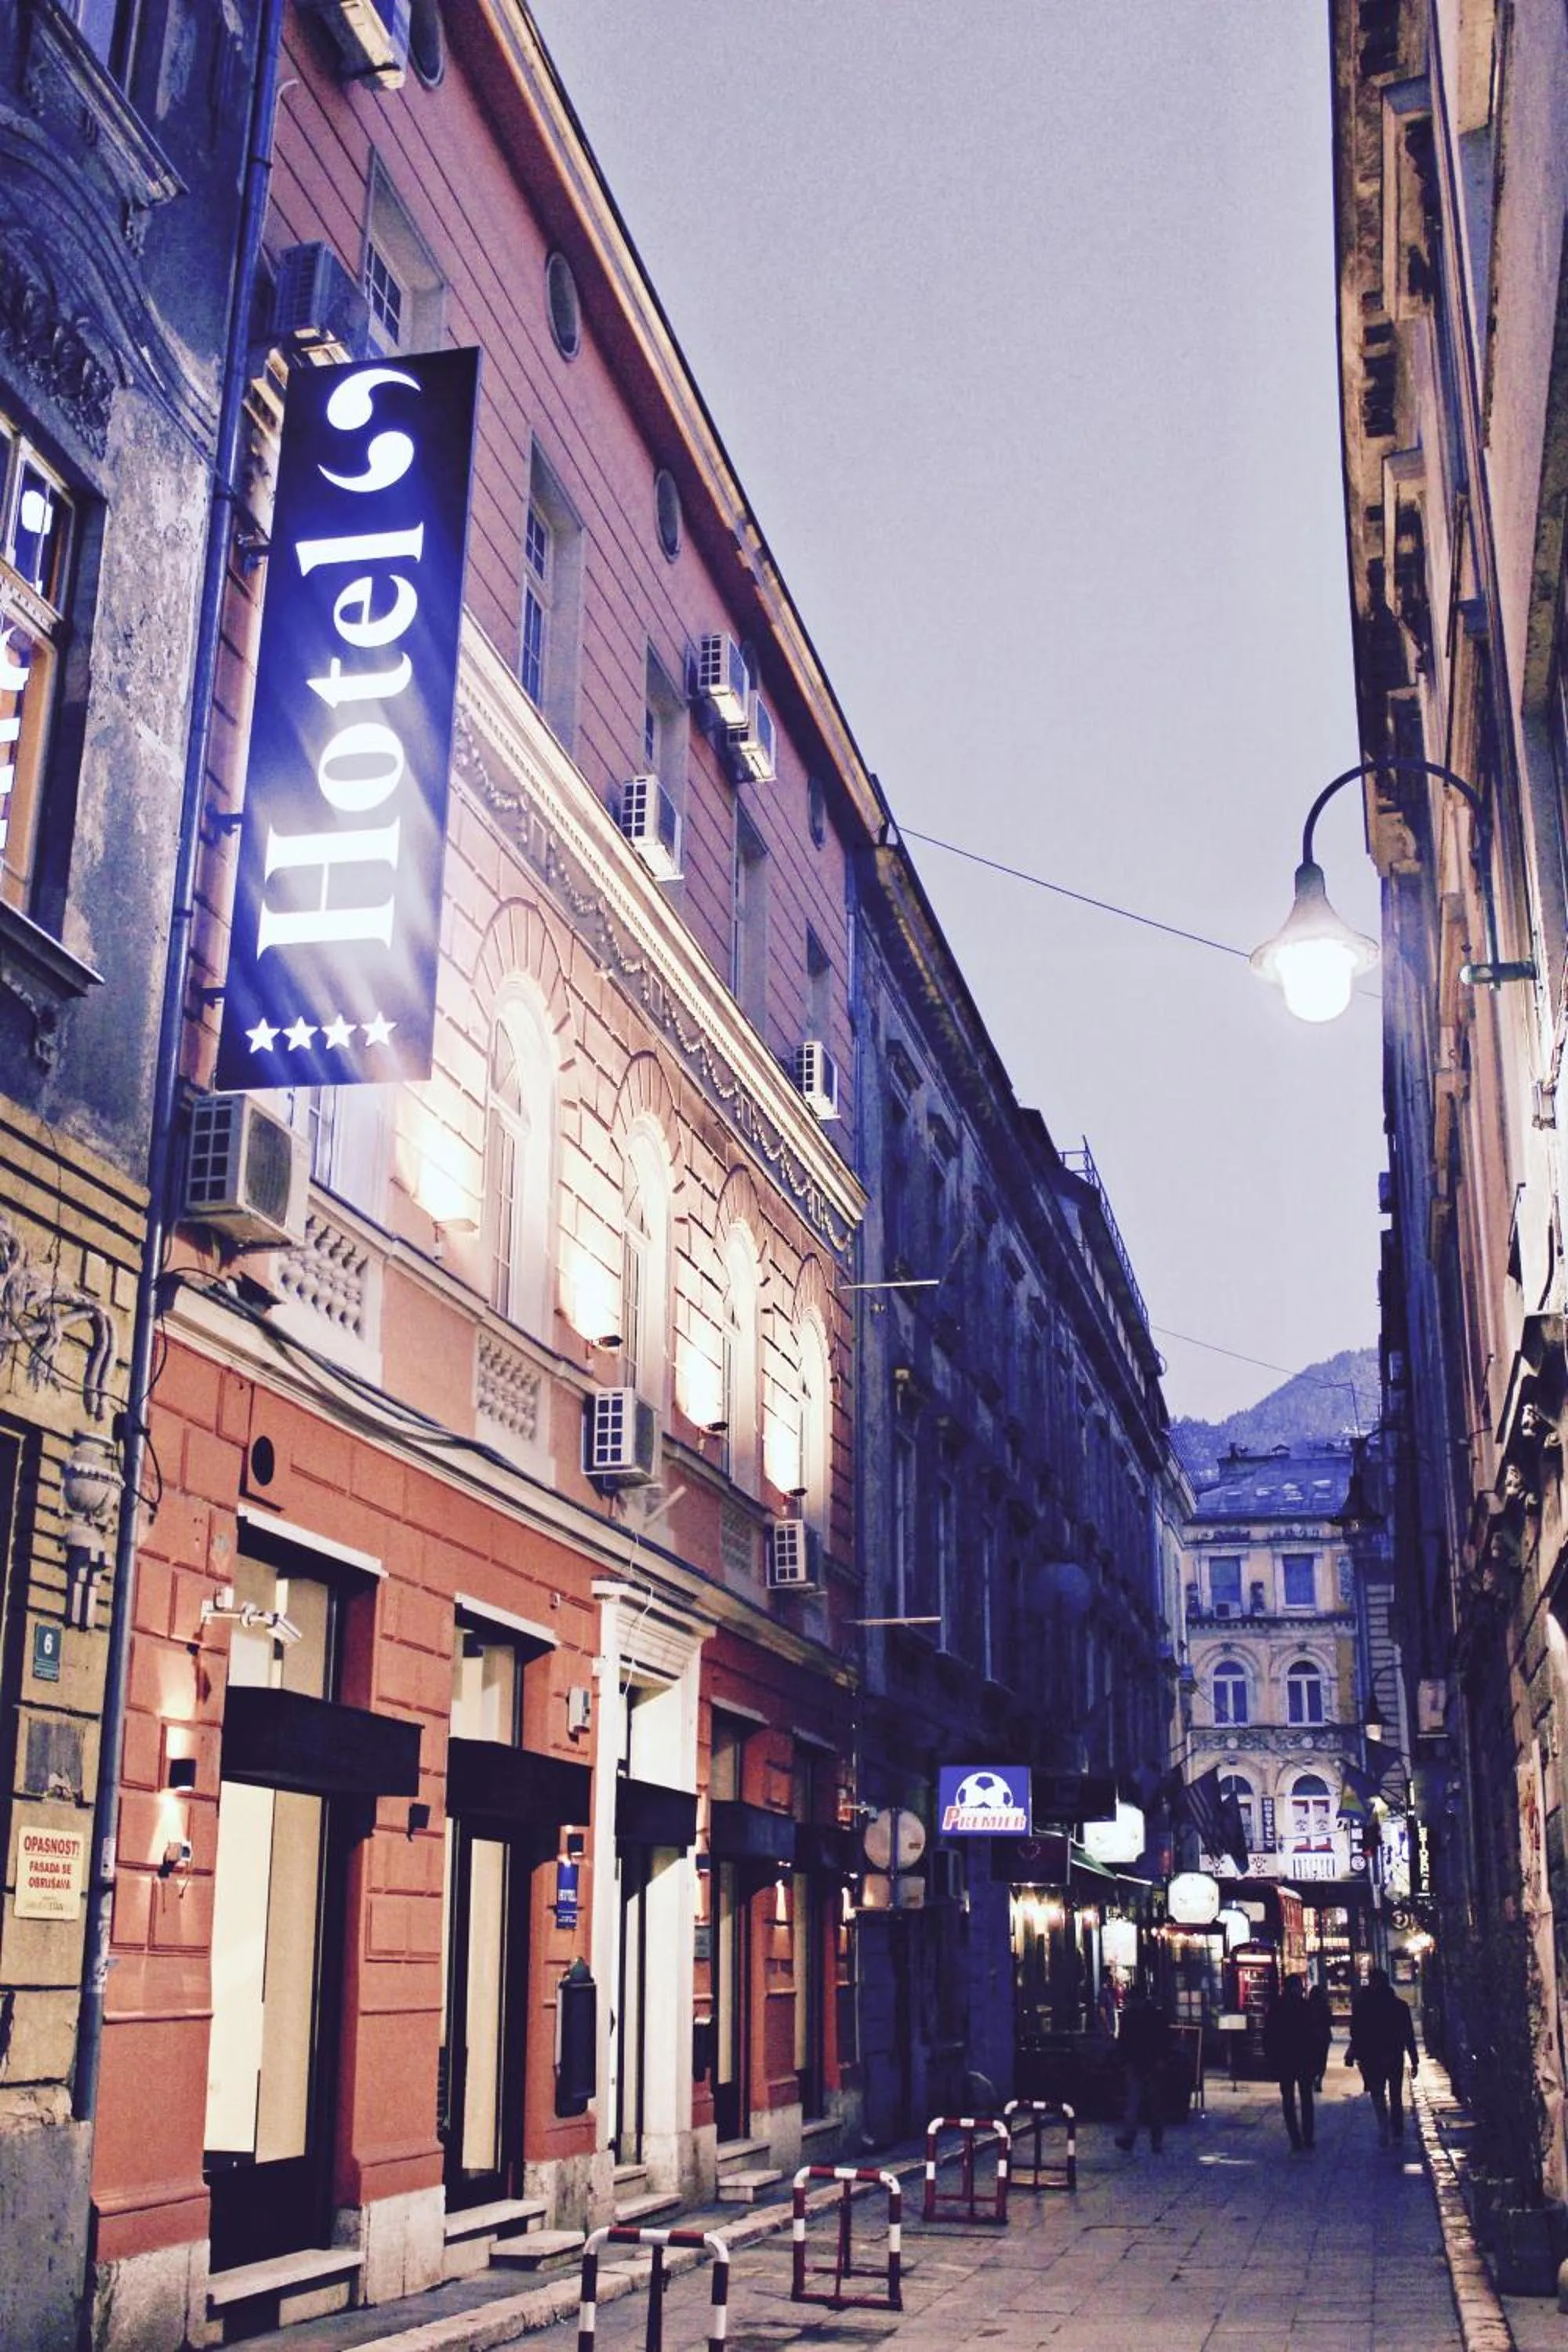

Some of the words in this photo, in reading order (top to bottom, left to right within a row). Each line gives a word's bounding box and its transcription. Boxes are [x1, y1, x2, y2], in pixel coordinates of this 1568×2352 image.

[257, 521, 424, 962] Hotel
[44, 1632, 53, 1655] 6
[943, 1806, 1025, 1829] PREMIER
[1263, 1799, 1273, 1838] HOSTEL
[29, 1860, 60, 1874] FASADA
[62, 1864, 72, 1875] SE
